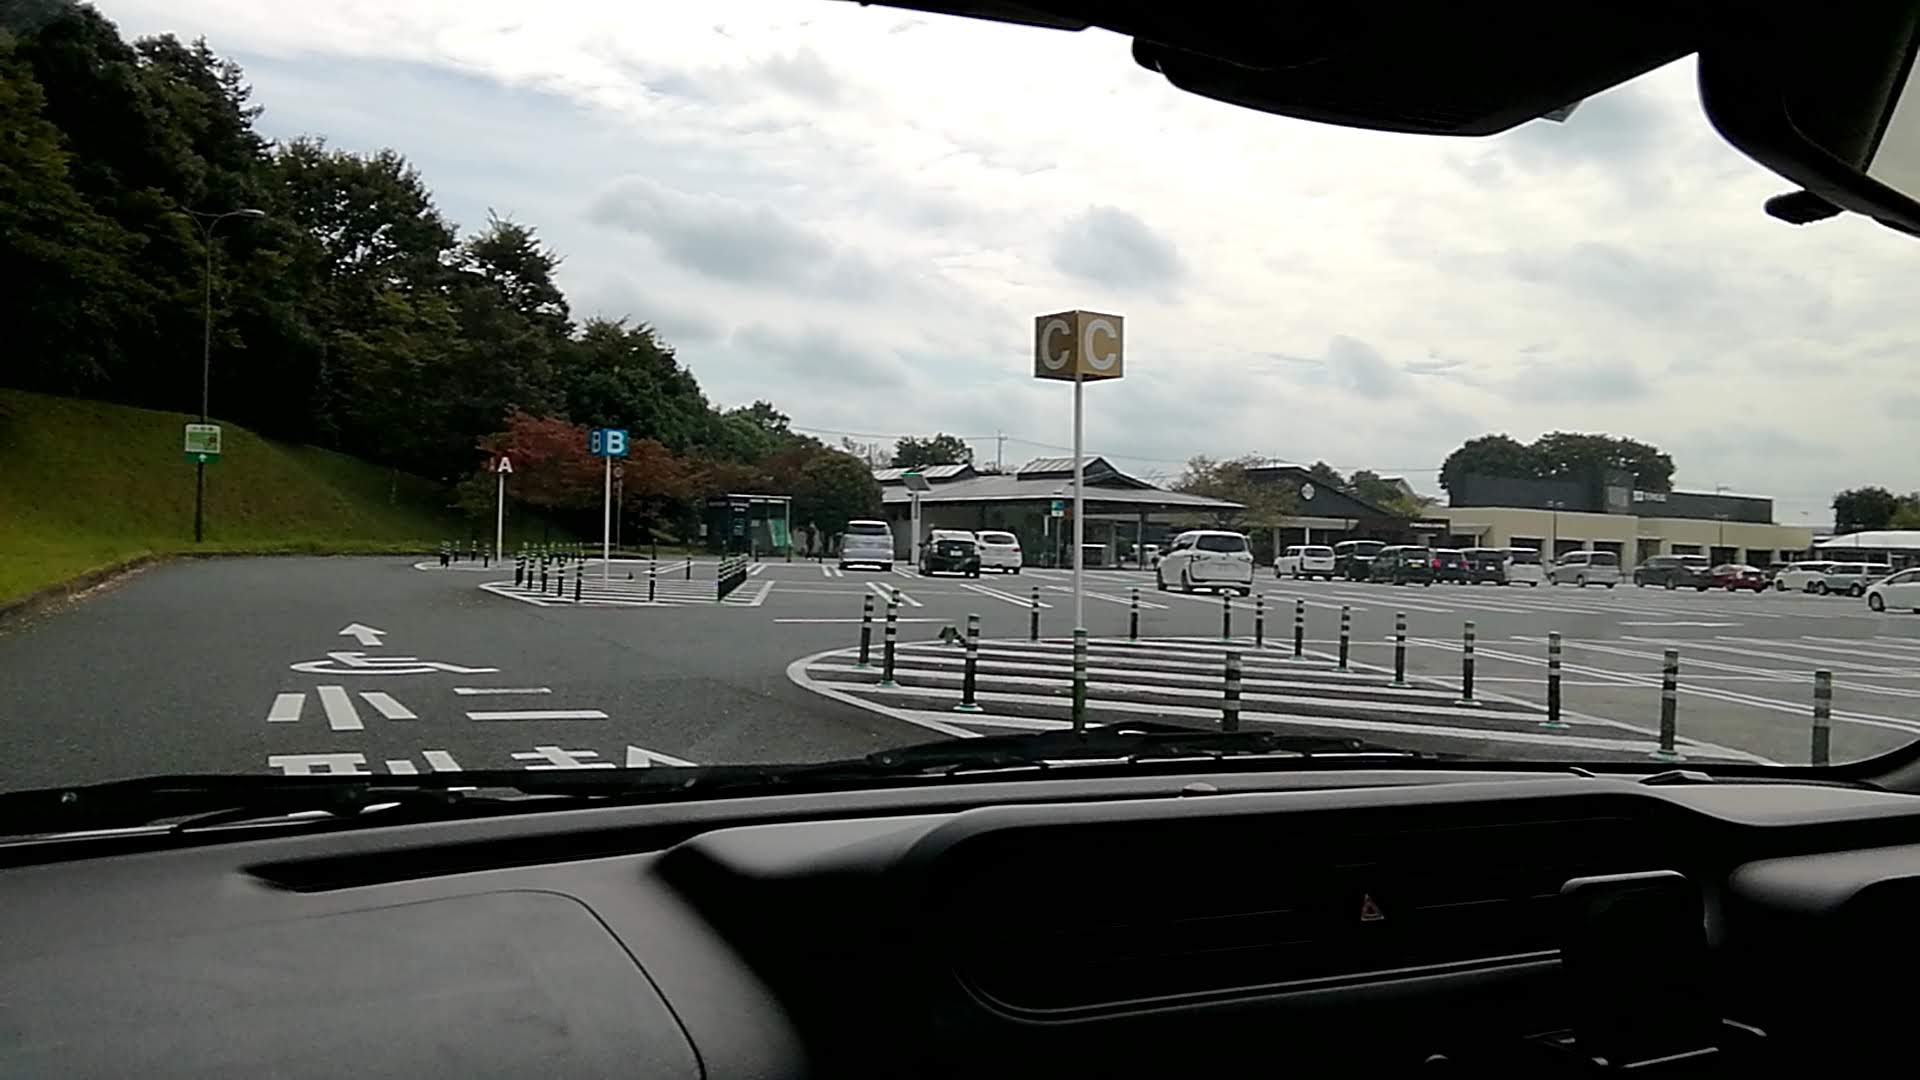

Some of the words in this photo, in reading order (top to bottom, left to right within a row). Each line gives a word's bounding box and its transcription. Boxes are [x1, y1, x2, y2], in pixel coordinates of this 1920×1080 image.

[1041, 319, 1070, 370] C
[1085, 319, 1117, 370] C
[607, 431, 624, 453] B
[498, 457, 512, 472] A
